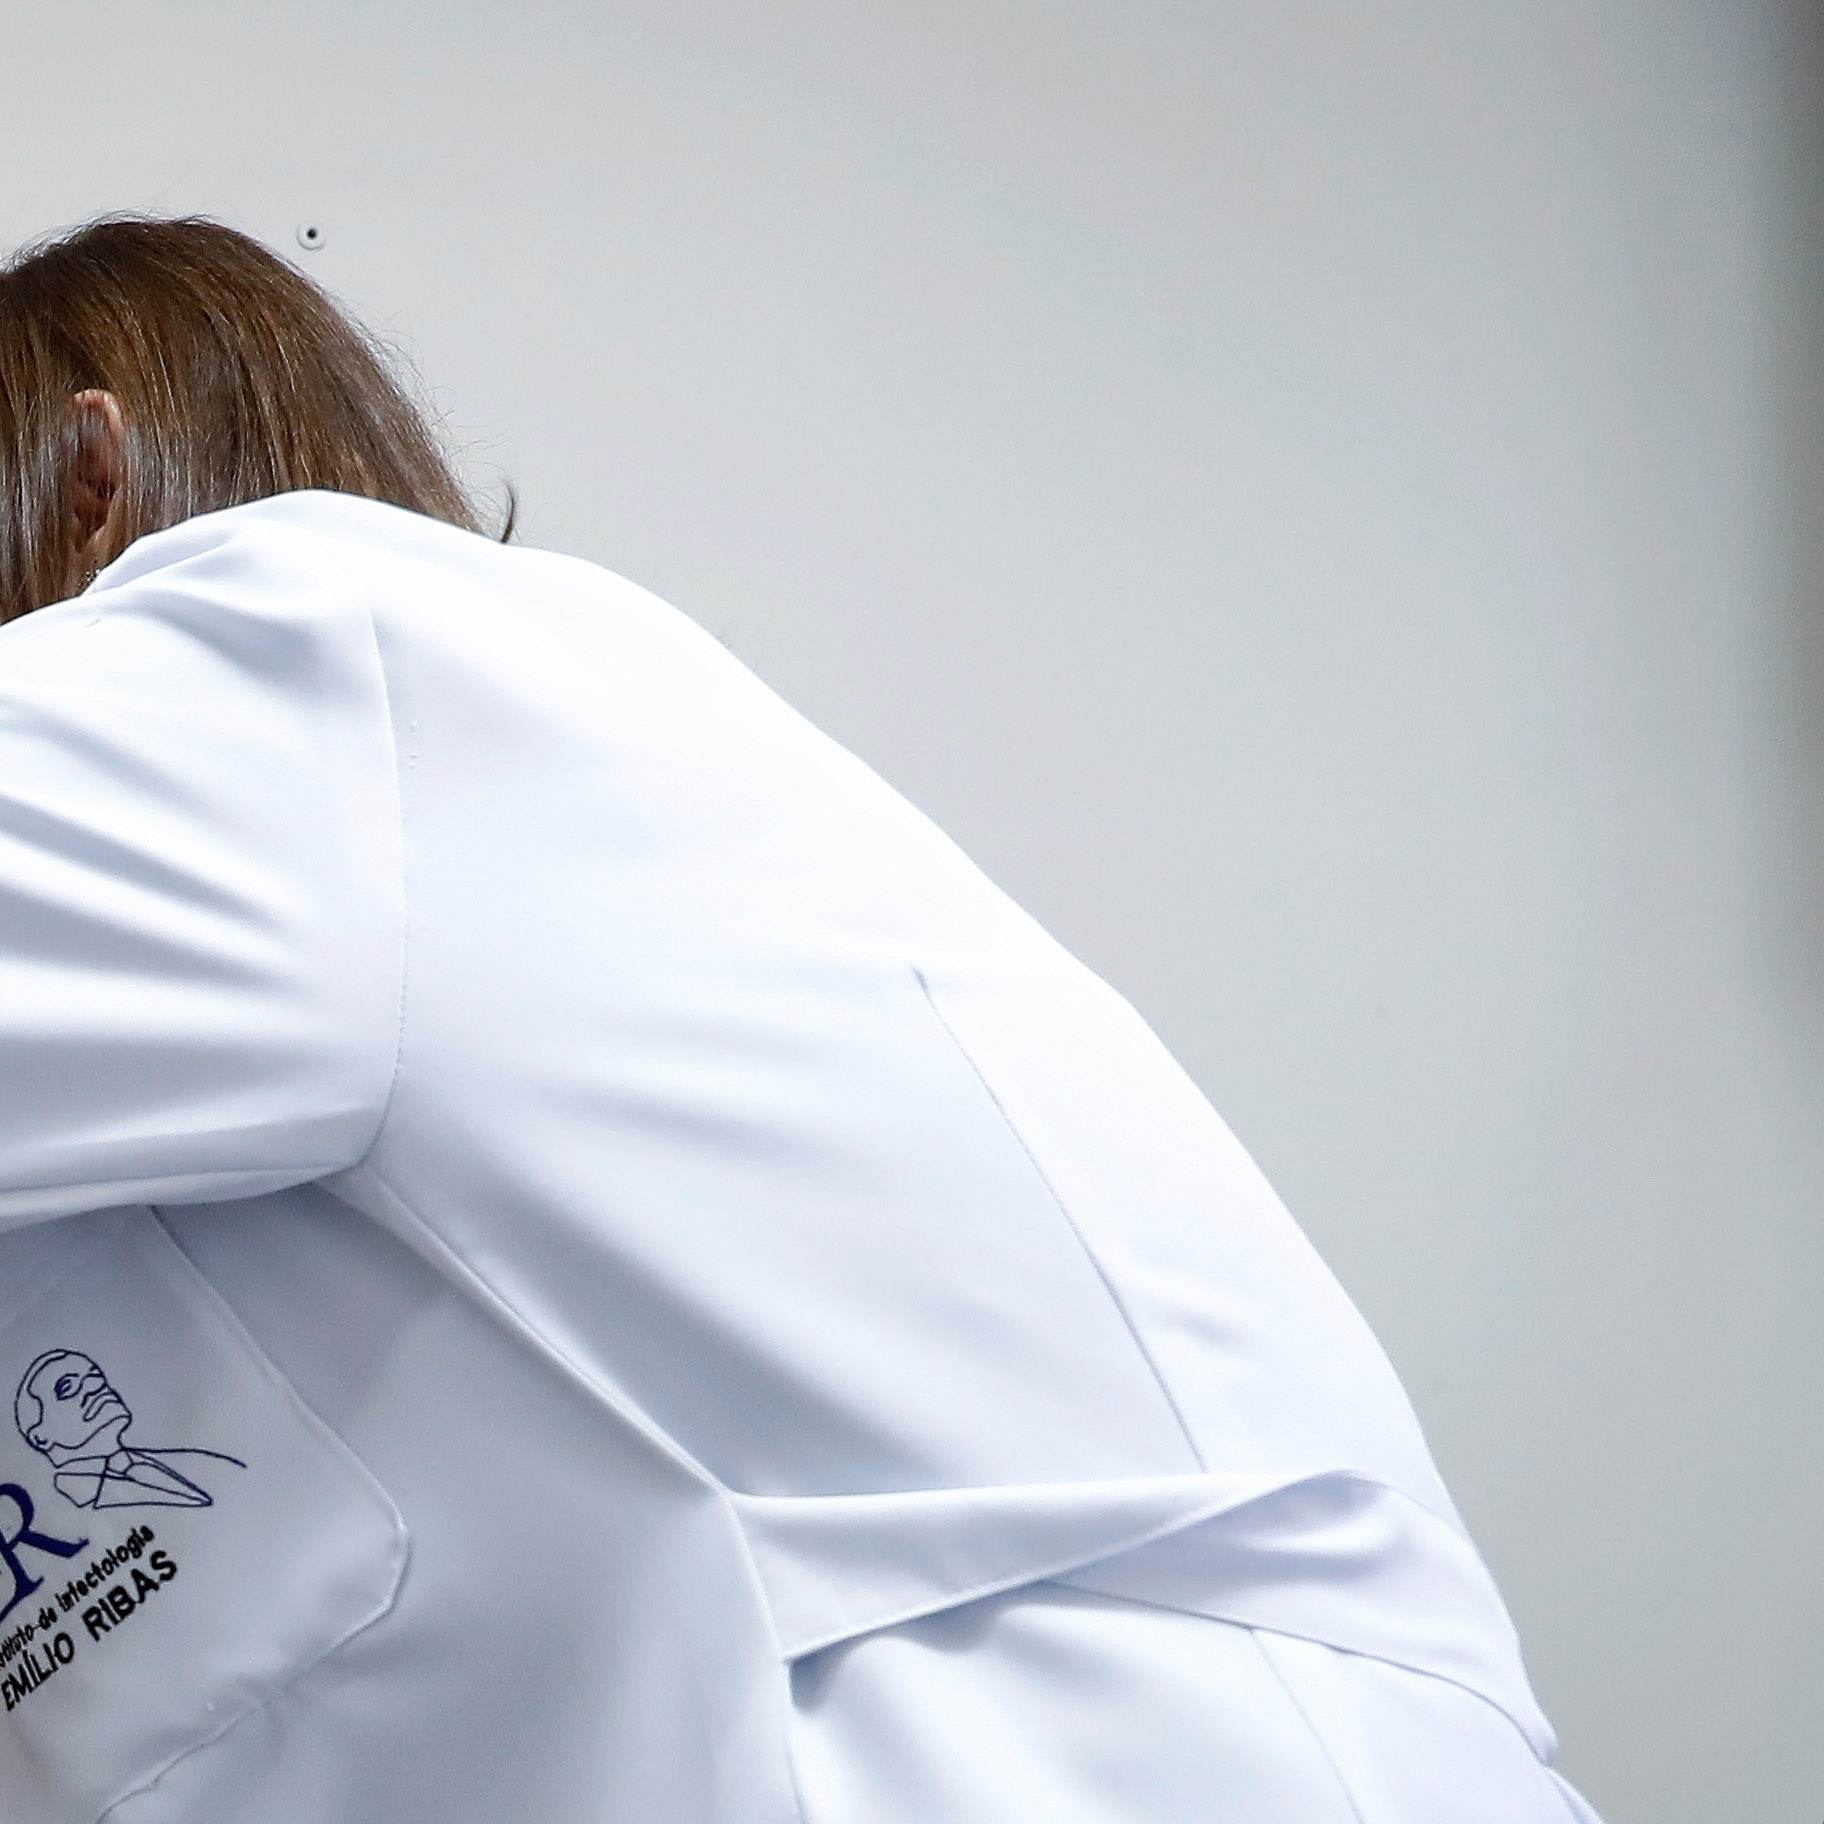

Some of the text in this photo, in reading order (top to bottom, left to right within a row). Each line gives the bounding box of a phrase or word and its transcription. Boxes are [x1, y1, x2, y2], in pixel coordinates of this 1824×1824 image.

[0, 1550, 178, 1711] EMÍLIO RIBAS
[38, 1607, 59, 1631] de
